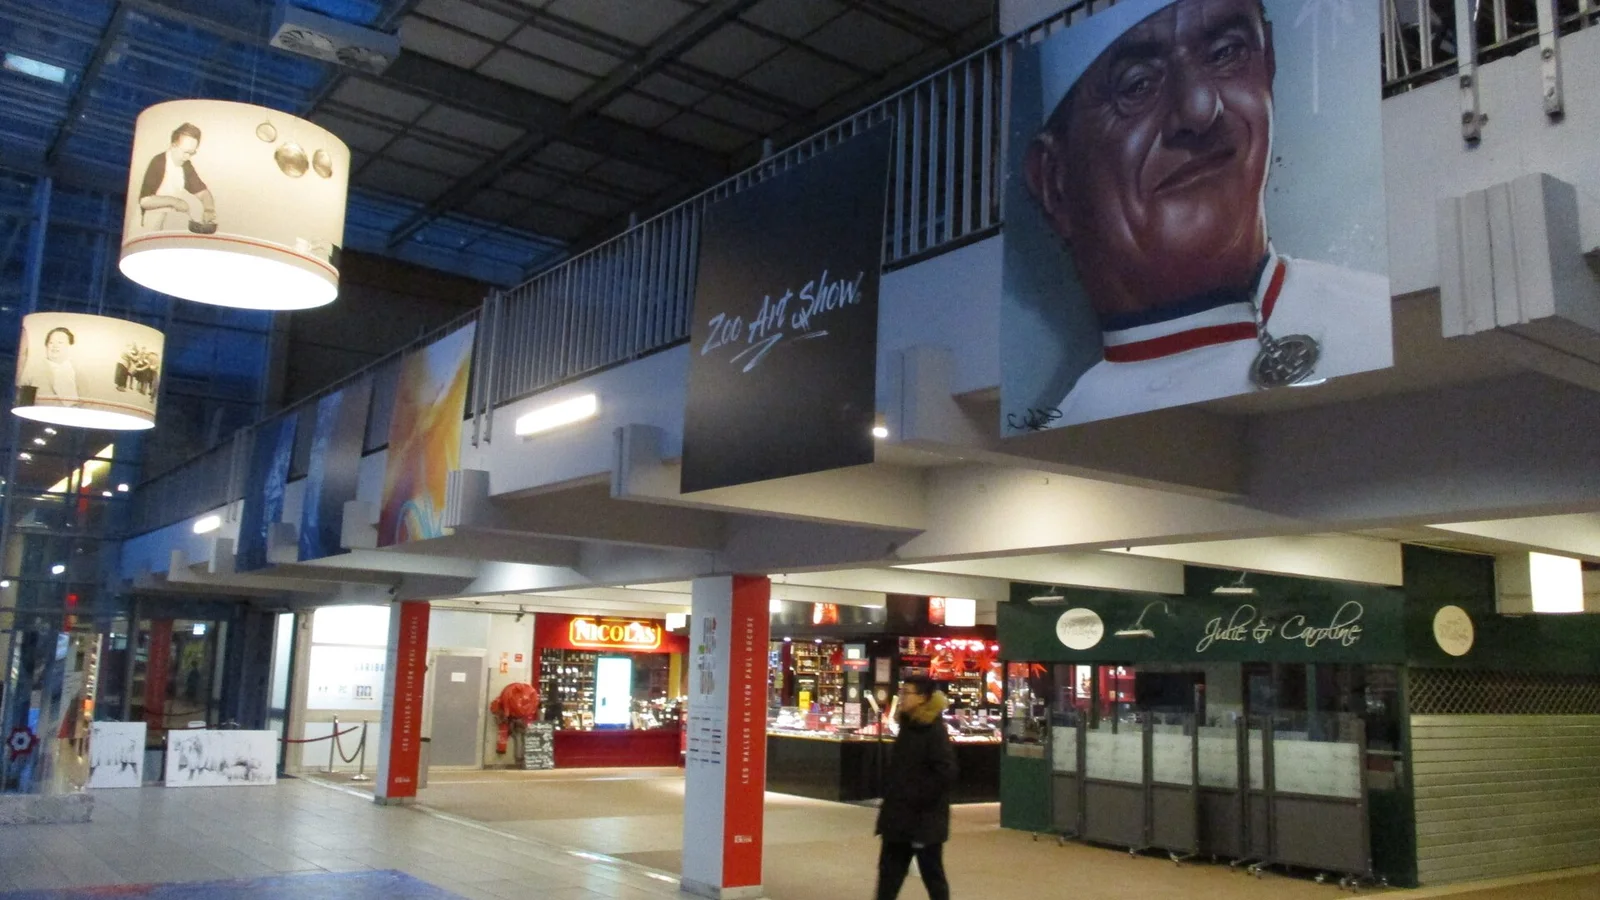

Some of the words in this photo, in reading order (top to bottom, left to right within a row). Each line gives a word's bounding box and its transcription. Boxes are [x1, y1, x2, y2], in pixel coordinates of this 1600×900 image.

[701, 312, 743, 356] Zoo
[747, 288, 793, 343] Art
[792, 269, 864, 332] Show
[574, 619, 656, 643] NICOLAS
[745, 617, 754, 652] BOCUSE
[1196, 604, 1257, 653] Julie
[1280, 600, 1364, 648] Caroline
[744, 657, 753, 679] PAUL
[744, 684, 752, 707] LYON
[742, 727, 751, 763] HALLES
[741, 767, 750, 785] LES
